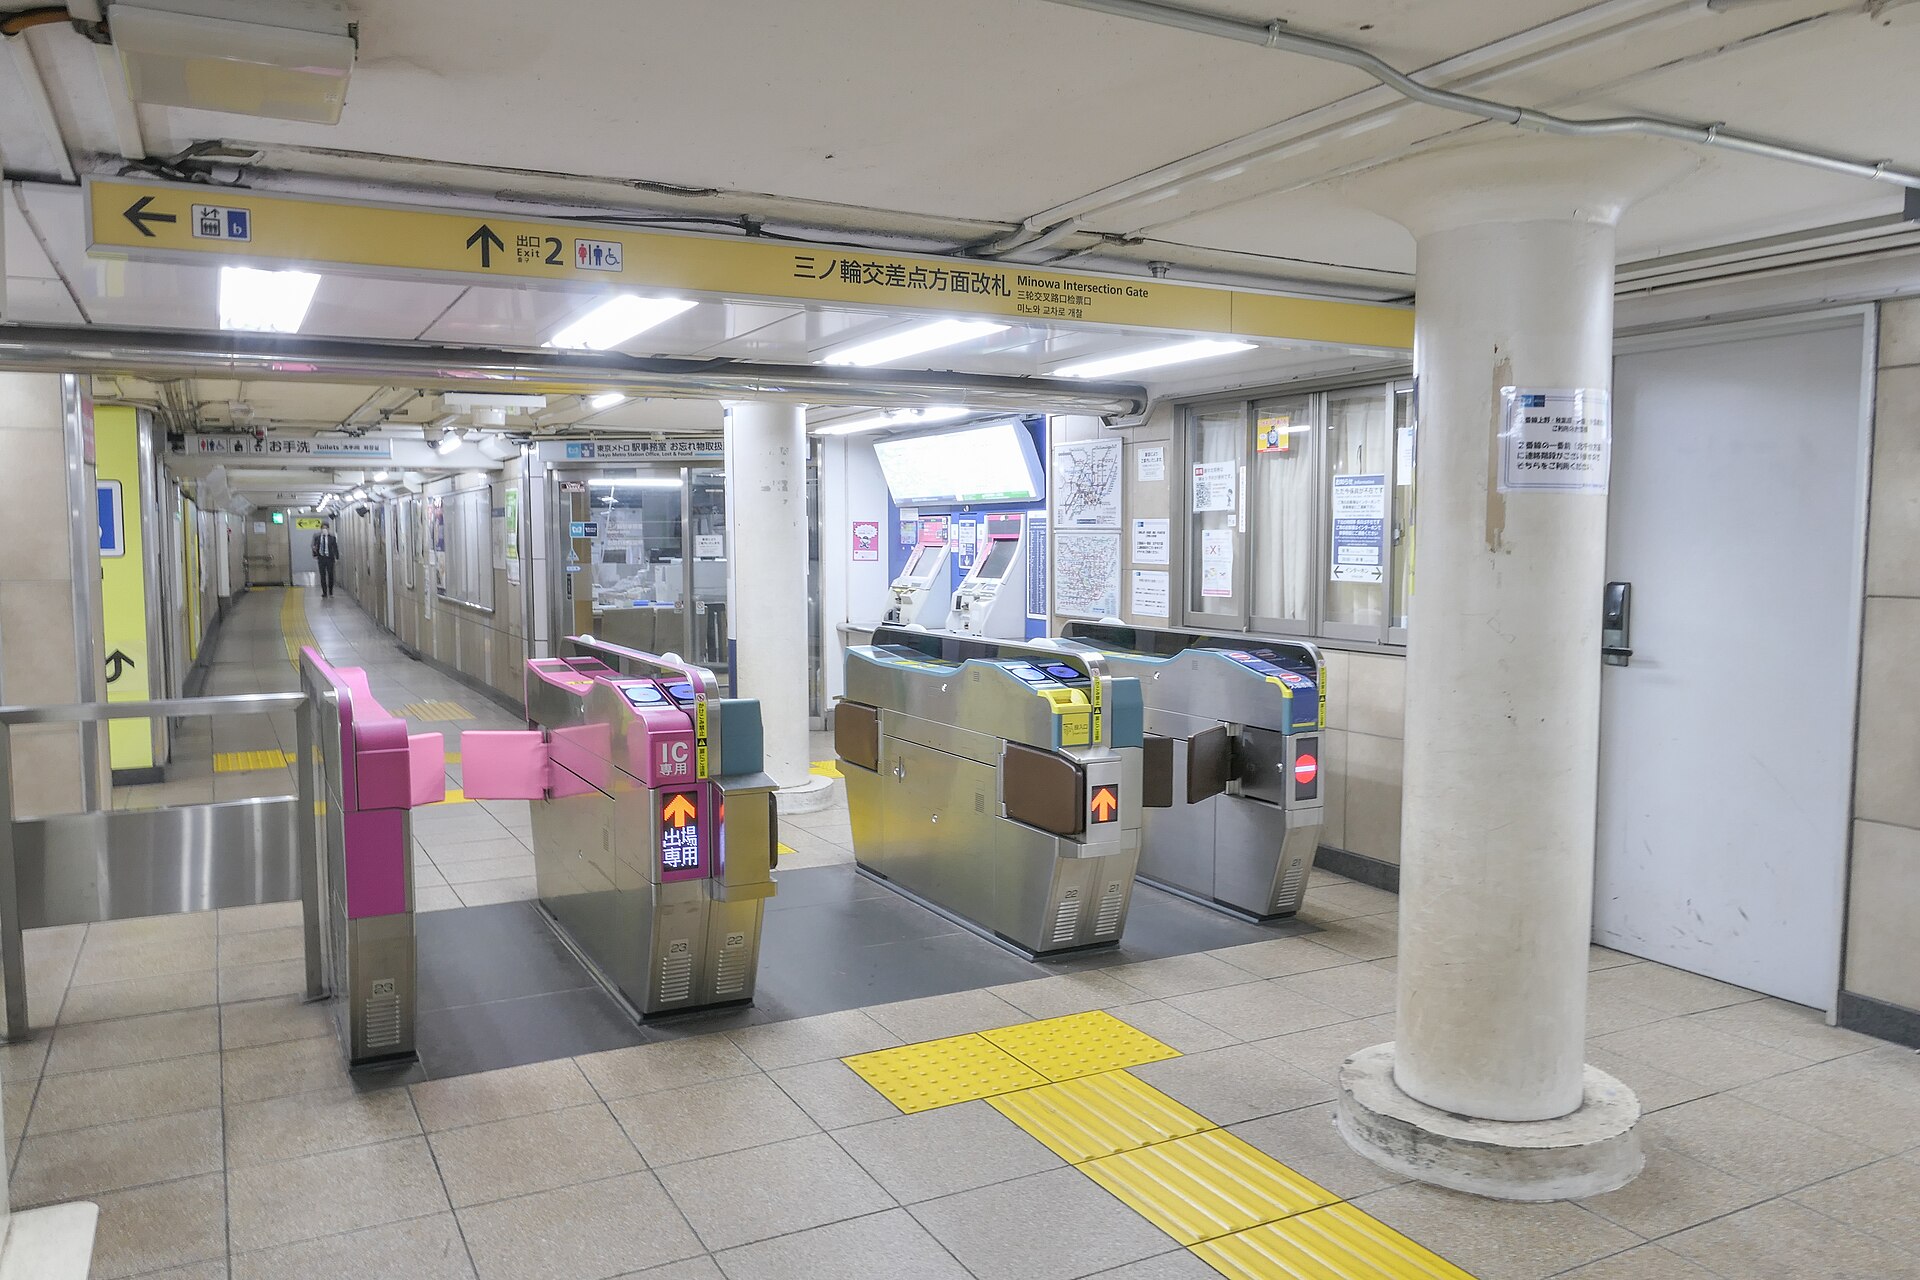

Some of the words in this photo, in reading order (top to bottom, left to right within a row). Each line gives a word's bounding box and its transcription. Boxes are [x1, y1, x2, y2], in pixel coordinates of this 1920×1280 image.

[516, 234, 540, 248] 出口
[544, 237, 564, 266] 2
[517, 248, 540, 258] Exit
[794, 256, 1010, 297] 三ノ輪交差点方面改札
[1018, 275, 1060, 290] Minowa
[1063, 280, 1122, 295] Intersection
[1126, 286, 1148, 298] Gate
[1017, 290, 1092, 306] 三轮交叉路口检票口
[1017, 304, 1040, 314] 미노와
[1043, 306, 1066, 316] 교차로
[270, 440, 310, 453] お手洗
[632, 442, 666, 451] 駅事務室
[662, 742, 688, 762] IC
[660, 762, 686, 776] 専用
[662, 826, 698, 847] 出場
[662, 847, 698, 868] 専用
[1292, 858, 1302, 866] 21
[1065, 890, 1078, 898] 22
[1108, 884, 1120, 892] 21
[670, 942, 688, 953] 23
[727, 936, 744, 946] 22
